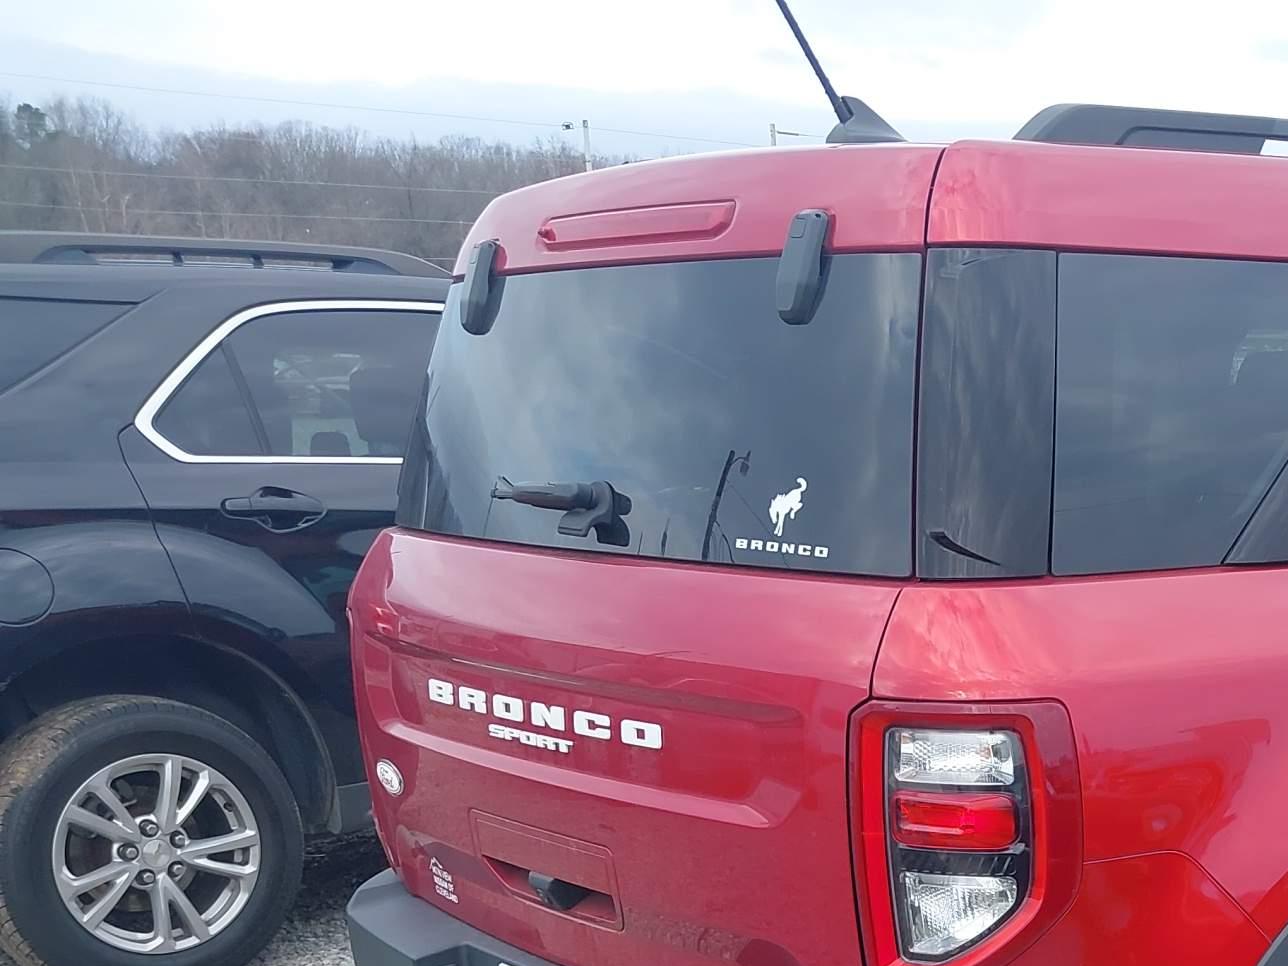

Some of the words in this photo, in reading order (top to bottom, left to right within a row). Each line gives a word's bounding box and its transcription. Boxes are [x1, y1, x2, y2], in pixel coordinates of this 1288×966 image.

[735, 538, 829, 558] BRONCO
[428, 678, 663, 750] BRONCO
[488, 723, 574, 754] SPORT
